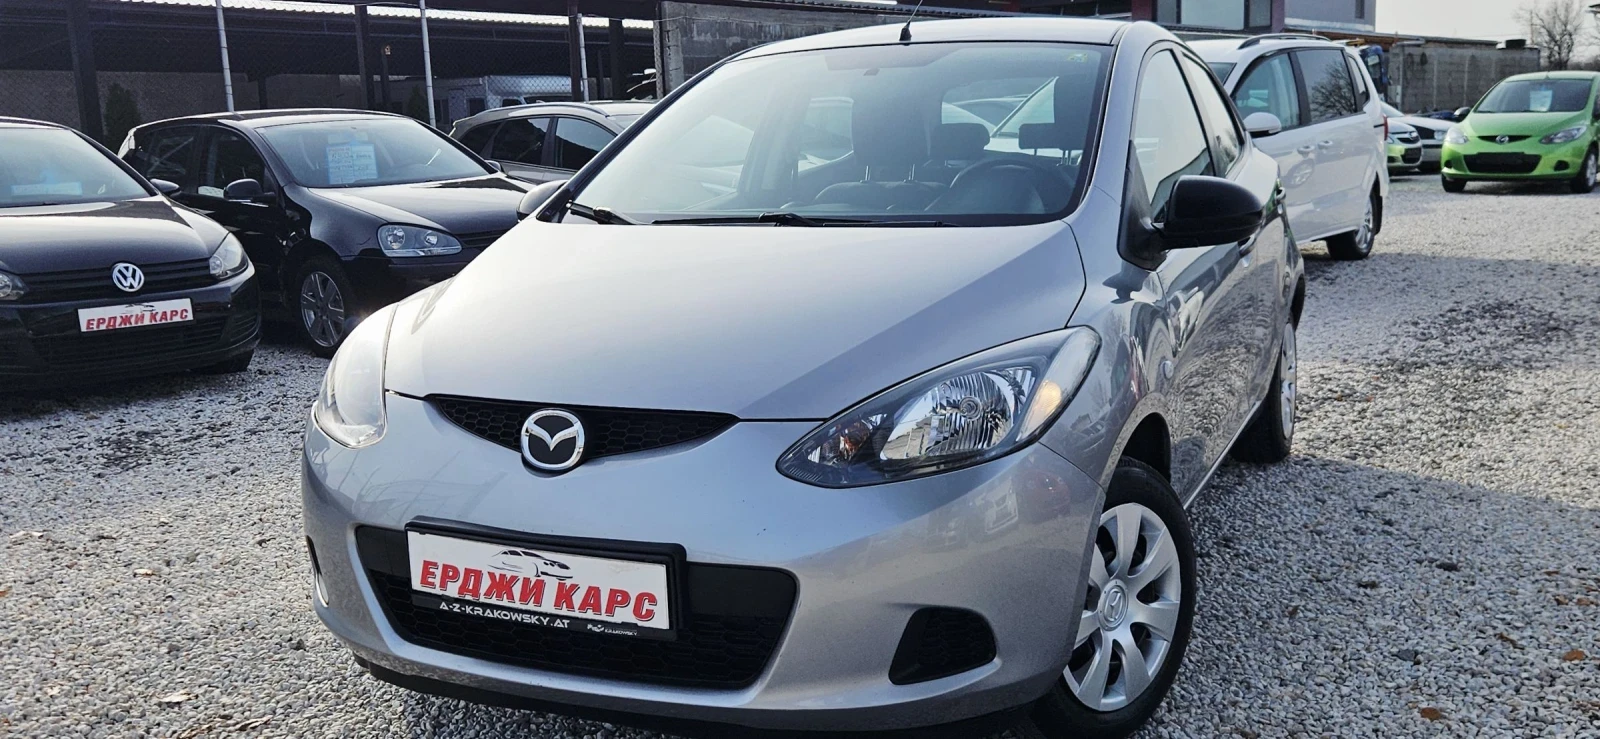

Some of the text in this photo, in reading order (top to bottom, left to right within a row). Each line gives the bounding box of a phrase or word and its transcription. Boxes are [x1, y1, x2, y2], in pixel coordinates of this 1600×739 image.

[85, 308, 189, 331] ЕРДЖИ КАРС
[419, 560, 658, 621] ЕРДЖИ КАРС
[439, 601, 570, 629] A-Z-KRAKOWSKY.AT
